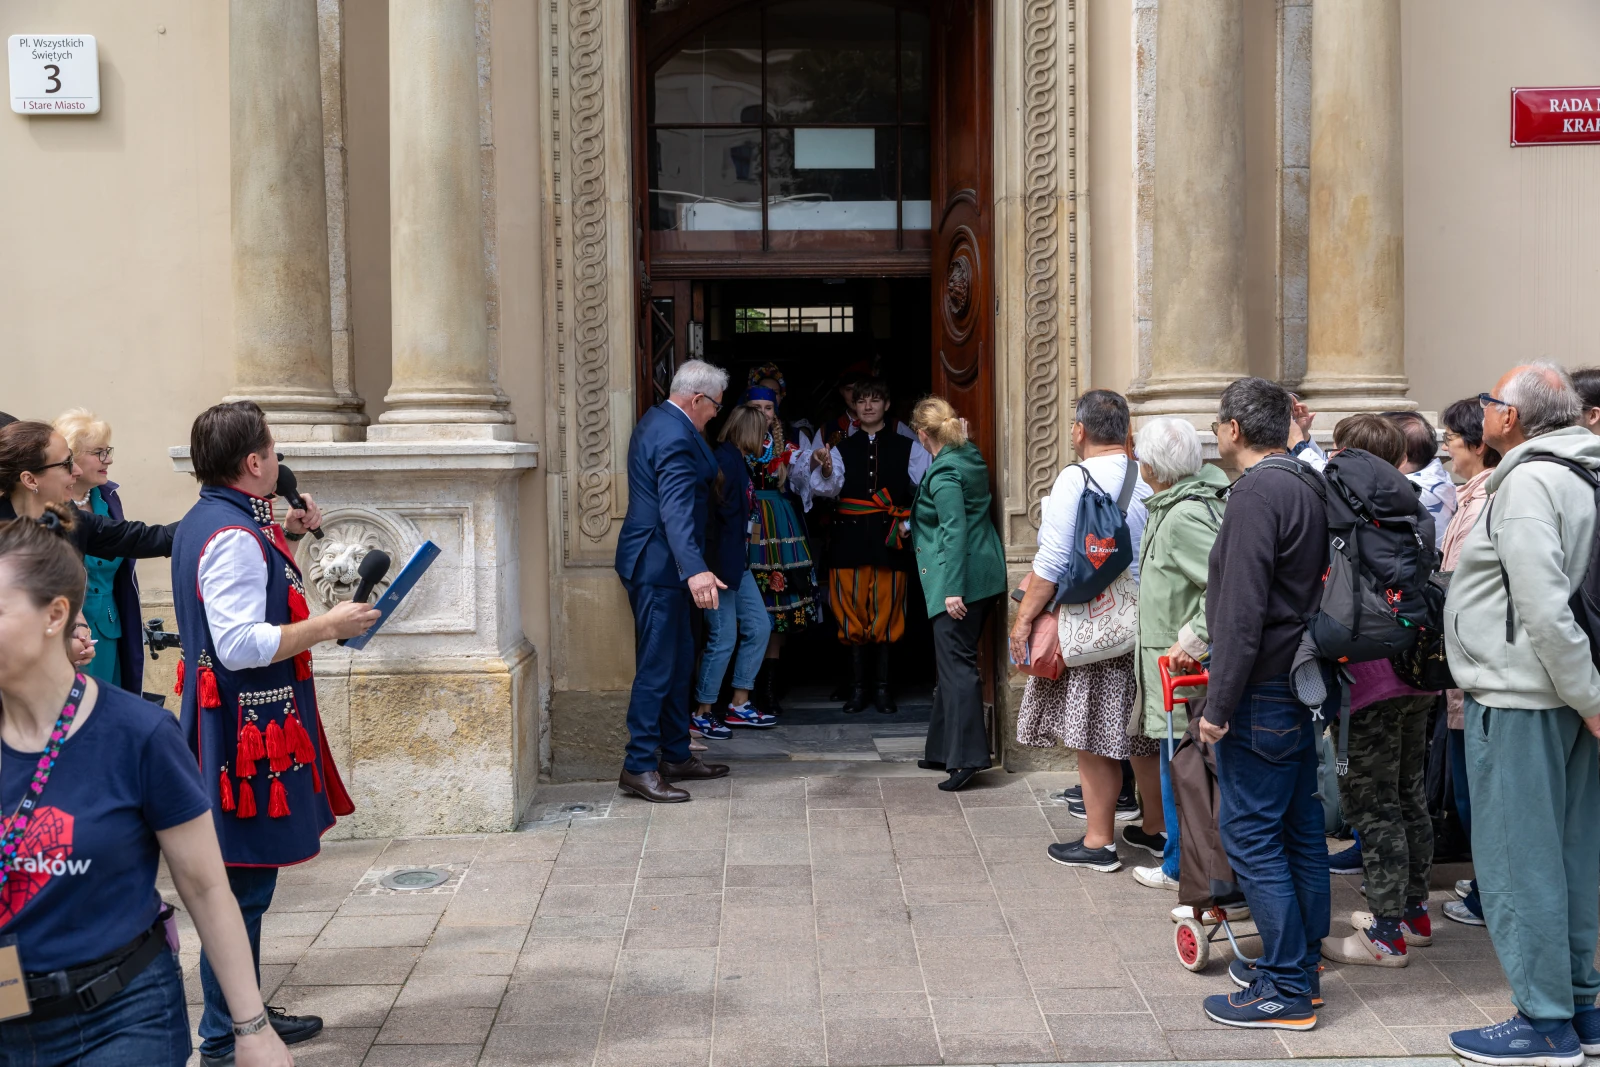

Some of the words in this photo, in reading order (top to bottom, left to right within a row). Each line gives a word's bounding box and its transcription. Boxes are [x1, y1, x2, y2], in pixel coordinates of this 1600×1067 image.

[20, 38, 31, 48] Pl.
[33, 38, 84, 50] Wszystkich
[32, 49, 73, 61] Świętych
[44, 64, 61, 93] 3
[23, 101, 26, 110] I
[29, 101, 52, 110] Stare
[54, 101, 85, 110] Miasto
[1549, 98, 1594, 113] RADA
[10, 851, 92, 876] raków
